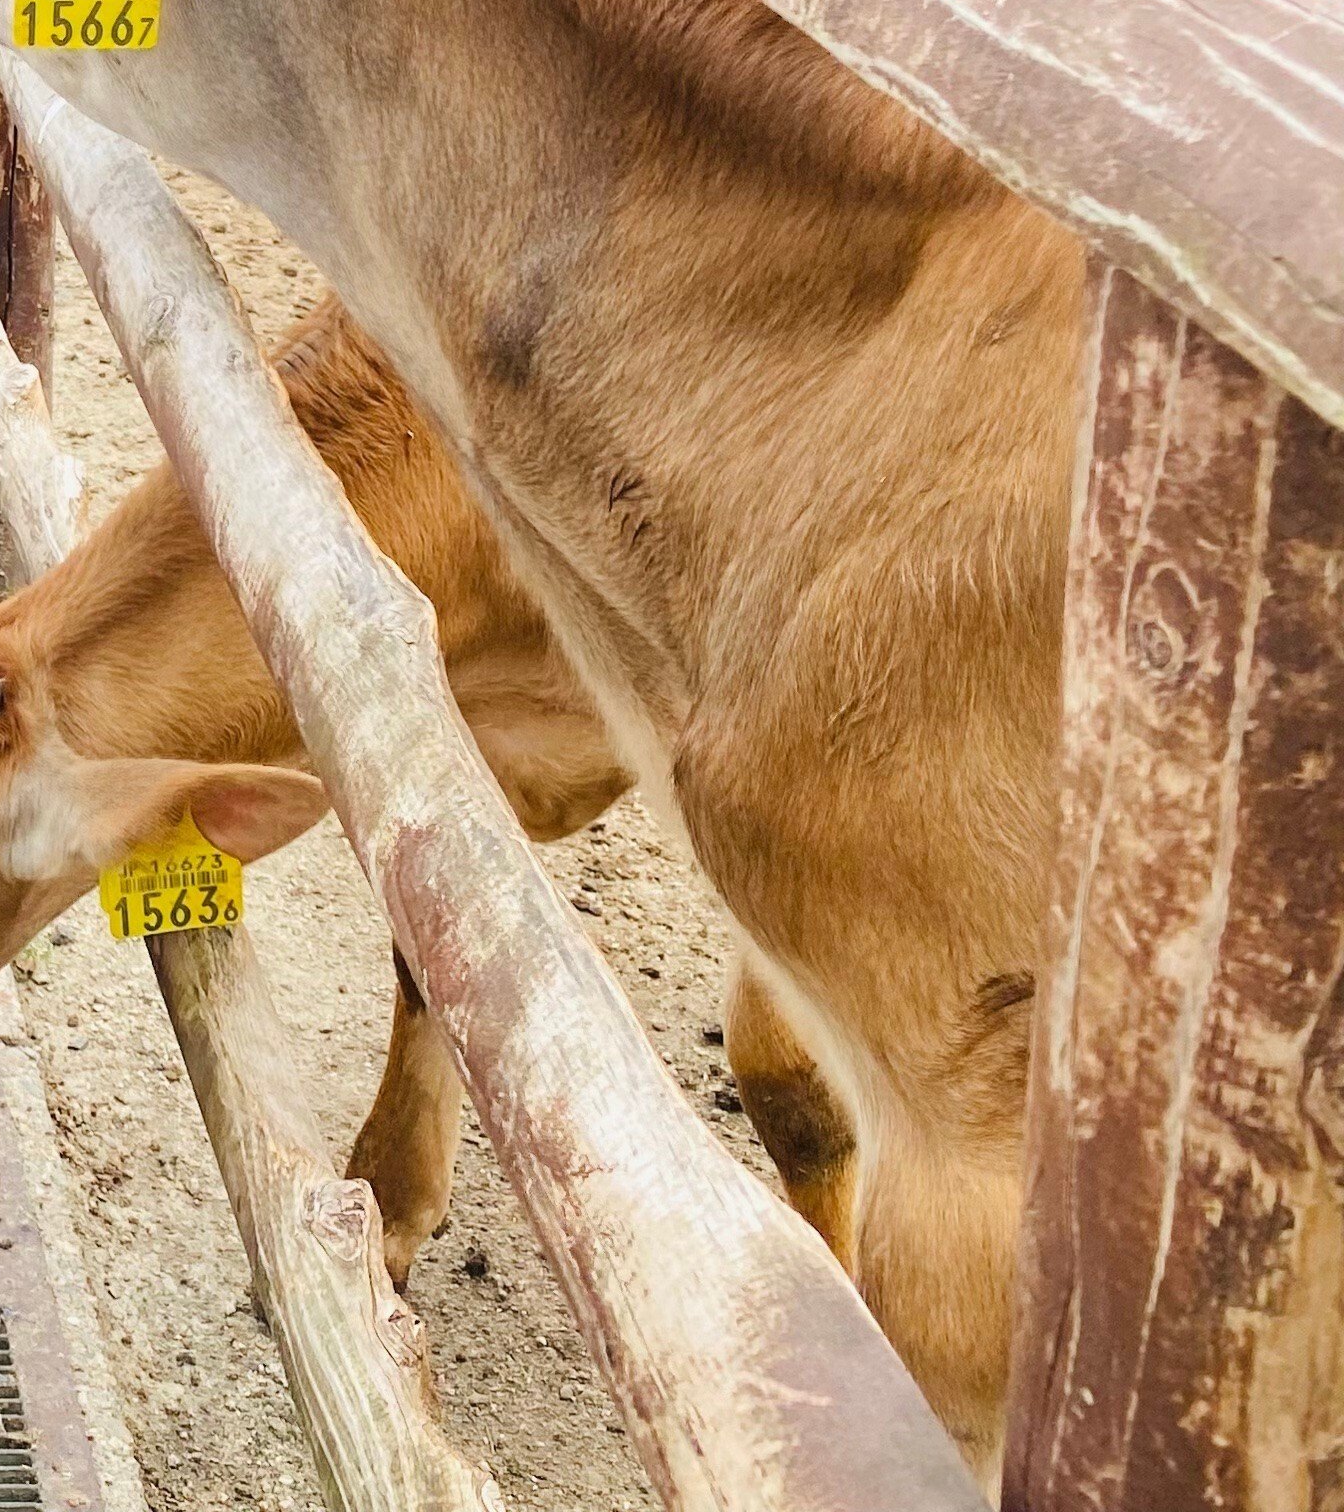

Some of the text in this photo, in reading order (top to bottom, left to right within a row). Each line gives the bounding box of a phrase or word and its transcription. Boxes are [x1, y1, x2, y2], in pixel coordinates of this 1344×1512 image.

[21, 0, 155, 46] 15667
[152, 854, 223, 874] 16673
[114, 885, 239, 937] 15636
